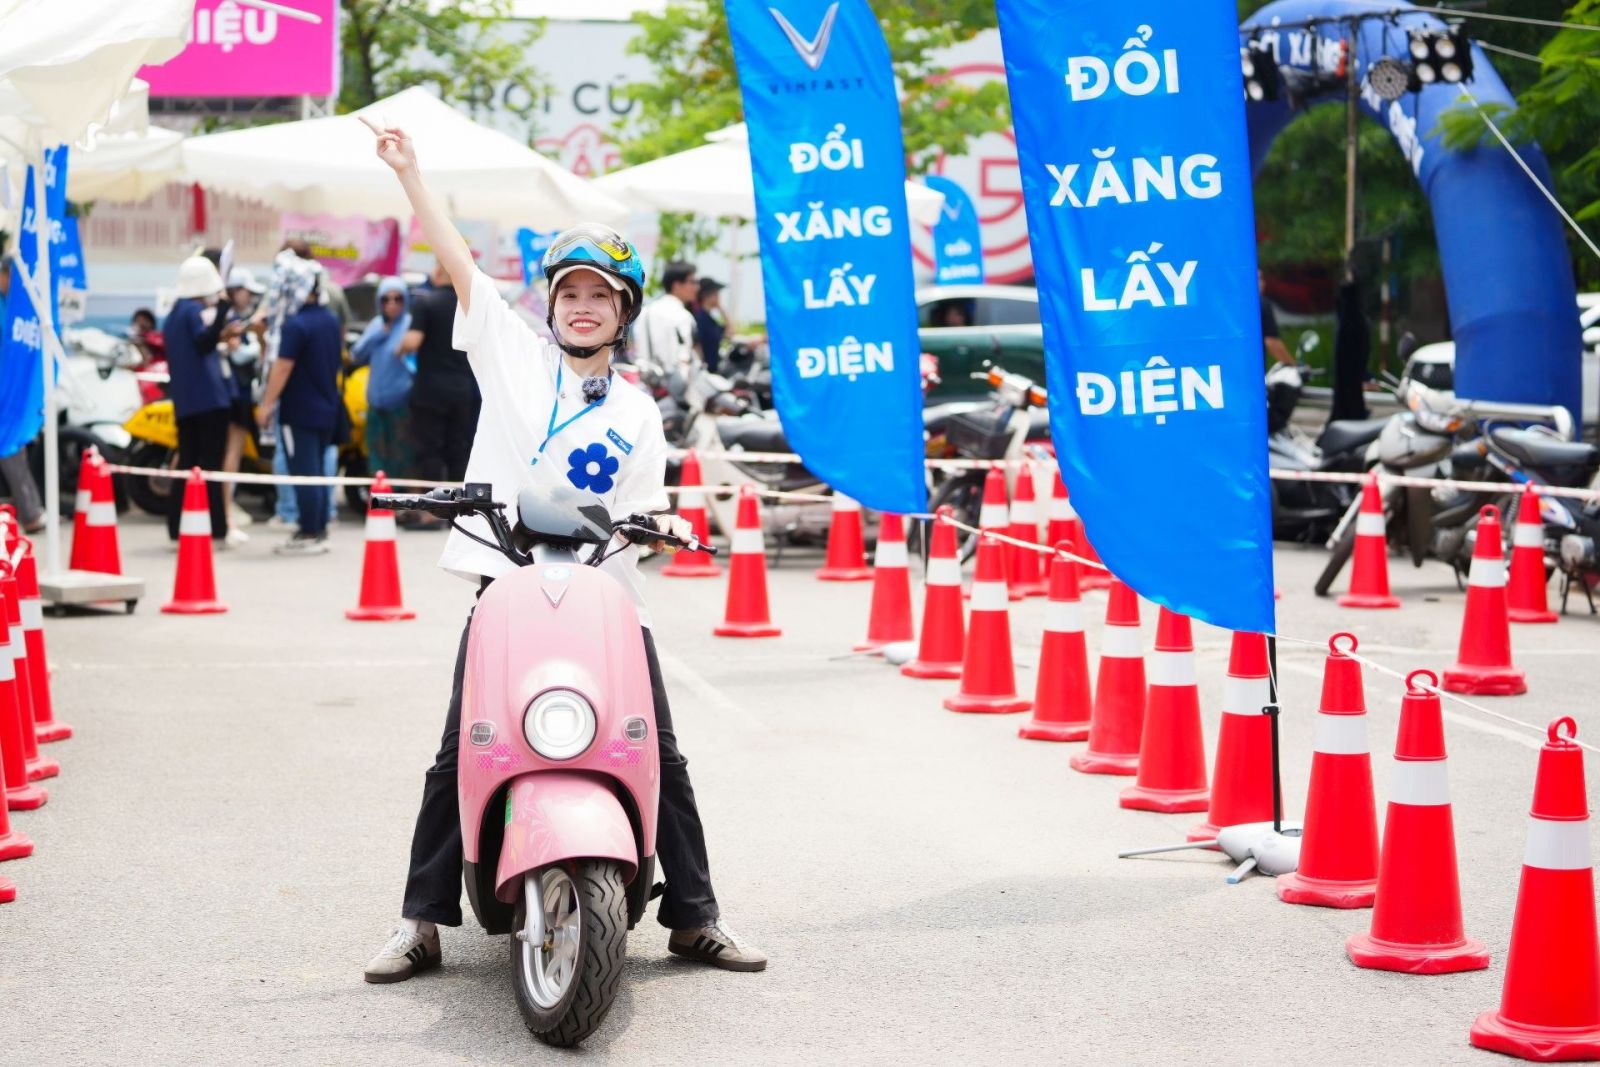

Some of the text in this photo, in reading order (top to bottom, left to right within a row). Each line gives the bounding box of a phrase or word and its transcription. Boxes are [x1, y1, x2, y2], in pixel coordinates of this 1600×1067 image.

[768, 77, 864, 95] VINFAST
[1065, 24, 1180, 101] ĐỔI
[788, 122, 865, 173] ĐỔI
[1045, 146, 1222, 208] XĂNG
[774, 200, 893, 243] XĂNG
[803, 262, 877, 309] LẤY
[1081, 241, 1199, 311] LẤY
[796, 335, 895, 382] ĐIỆN
[1076, 356, 1225, 425] ĐIỆN
